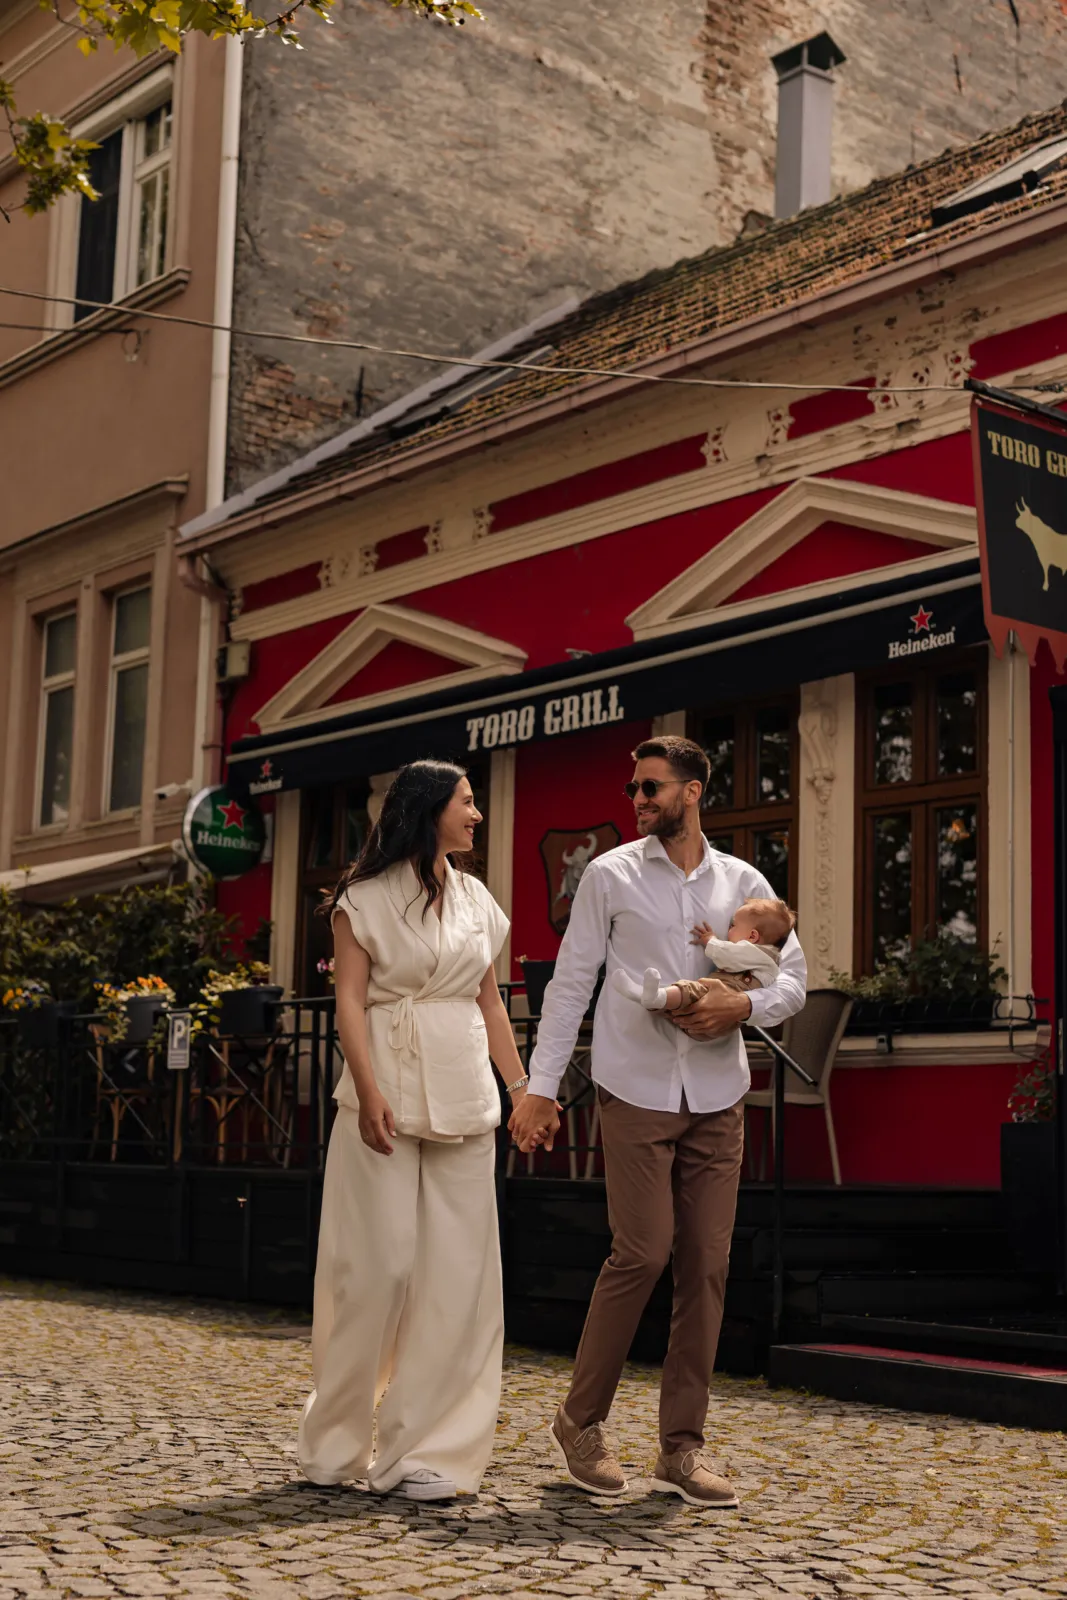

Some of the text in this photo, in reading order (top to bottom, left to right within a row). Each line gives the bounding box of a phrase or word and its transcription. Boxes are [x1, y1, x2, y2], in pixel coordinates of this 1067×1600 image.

[987, 430, 1040, 469] TORO
[887, 629, 955, 659] Heineken
[466, 685, 625, 751] TORO GRILL
[173, 1019, 186, 1049] P
